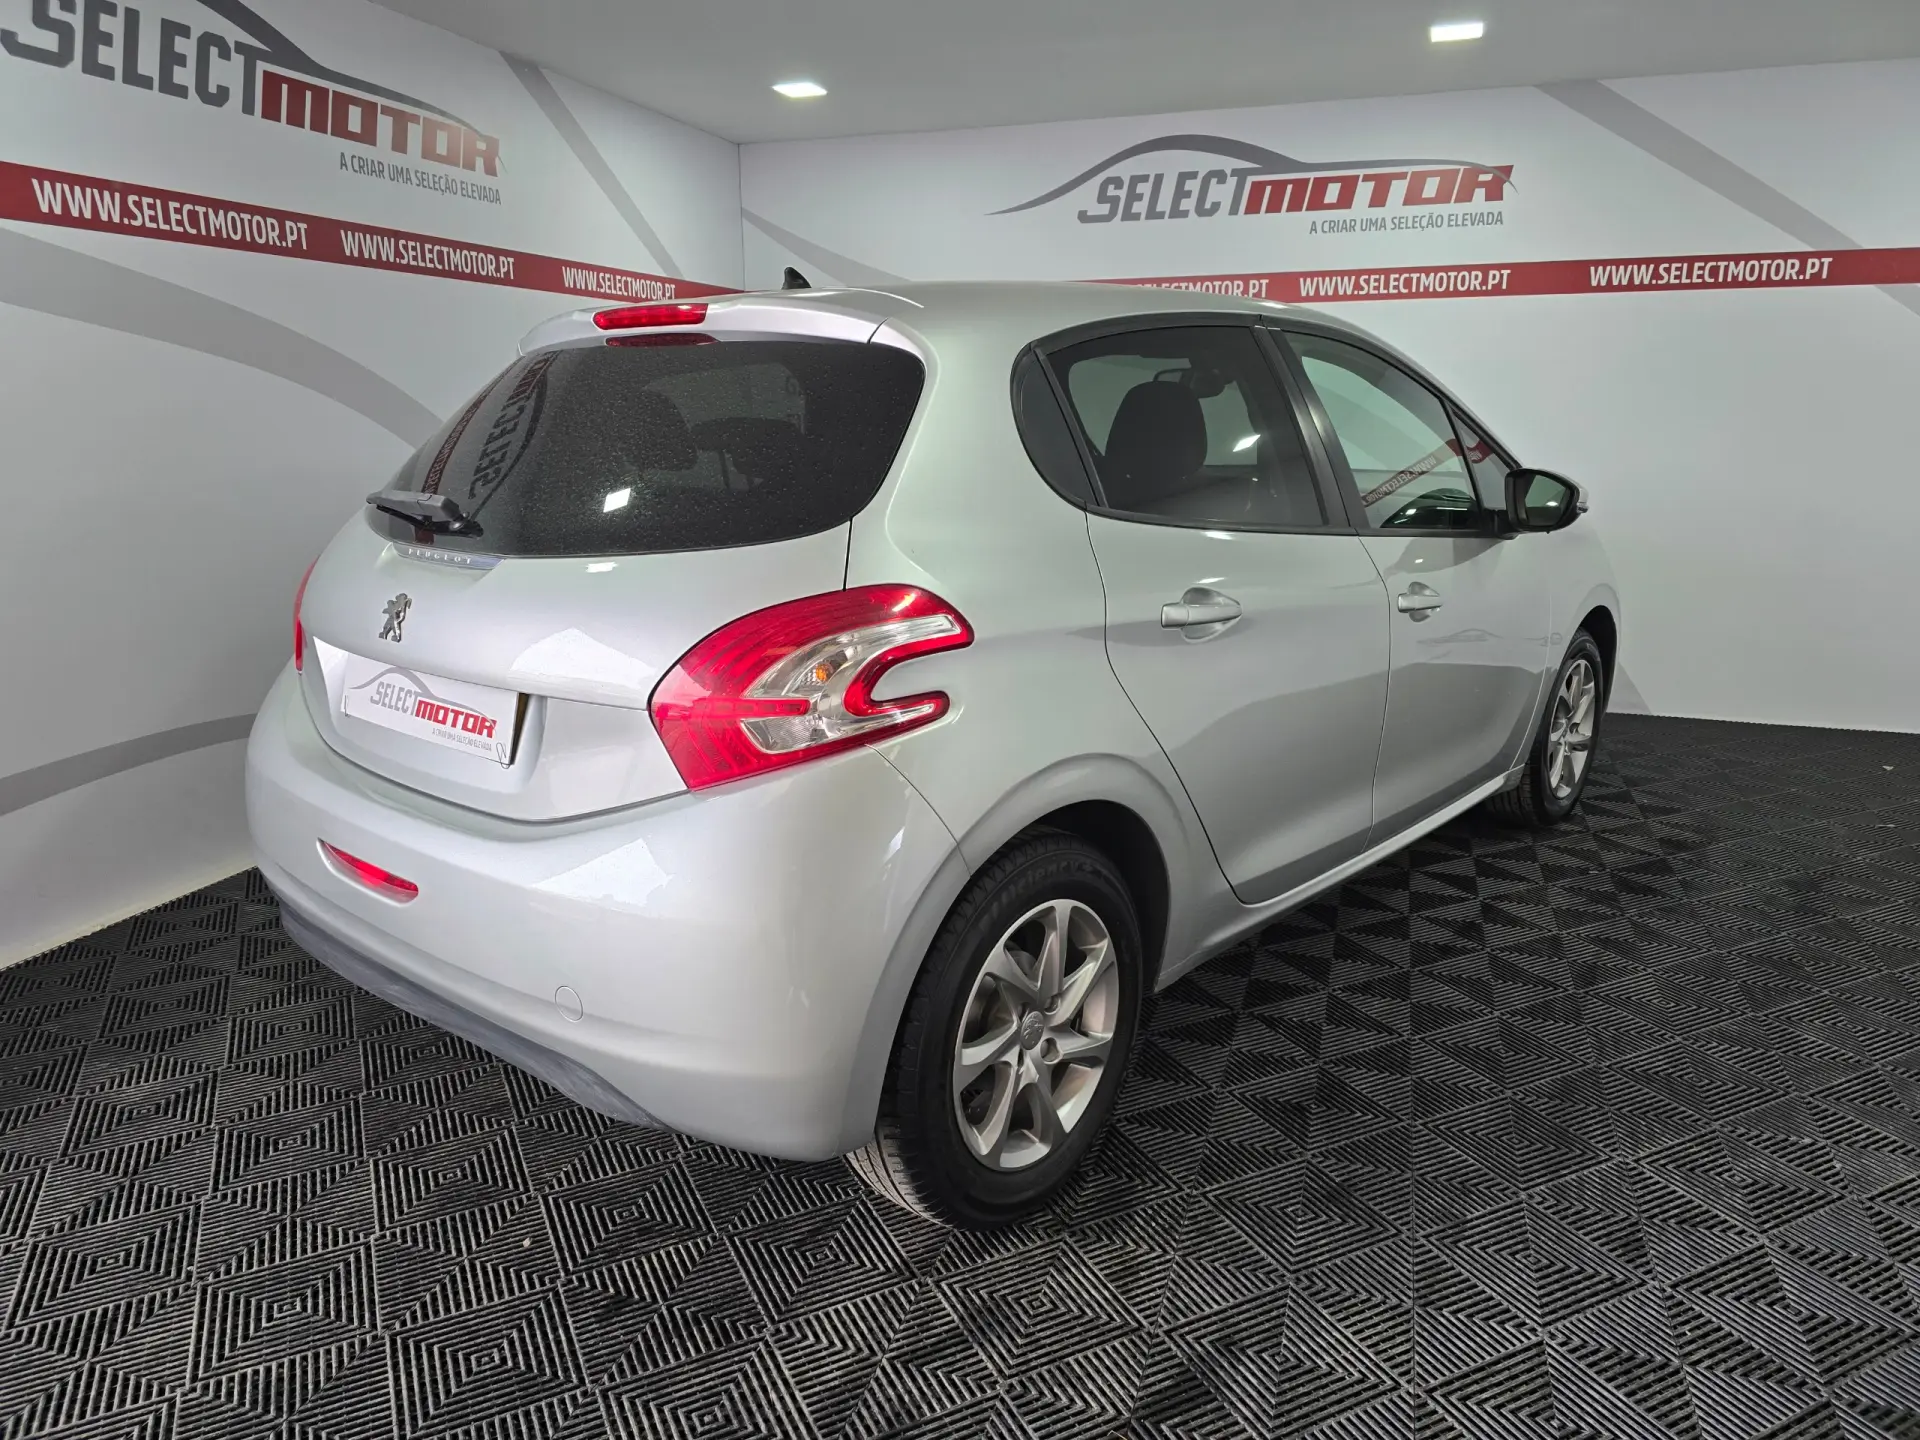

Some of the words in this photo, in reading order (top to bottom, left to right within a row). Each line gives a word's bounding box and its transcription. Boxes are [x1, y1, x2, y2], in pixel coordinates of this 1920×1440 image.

[339, 152, 349, 172] A
[351, 155, 386, 180] CRIAR
[387, 163, 413, 186] UMA
[414, 169, 458, 196] SELEÇÃO
[460, 180, 502, 205] ELEVADA
[31, 178, 308, 250] WWW.SELECTMOTOR.PT
[1309, 220, 1318, 235] A
[1321, 218, 1357, 234] CRIAR
[1360, 217, 1387, 232] UMA
[1390, 213, 1444, 232] SELEÇÃO
[1447, 211, 1504, 228] ELEVADA
[340, 229, 515, 280] WWW.SELECTMOTOR.PT
[562, 266, 676, 300] WWW.SELECTMOTOR.PT
[1300, 269, 1511, 297] WWW.SELECTMOTOR.PT
[1589, 257, 1832, 287] WWW.SELECTMOTOR.PT
[408, 548, 471, 564] PEUGEOT
